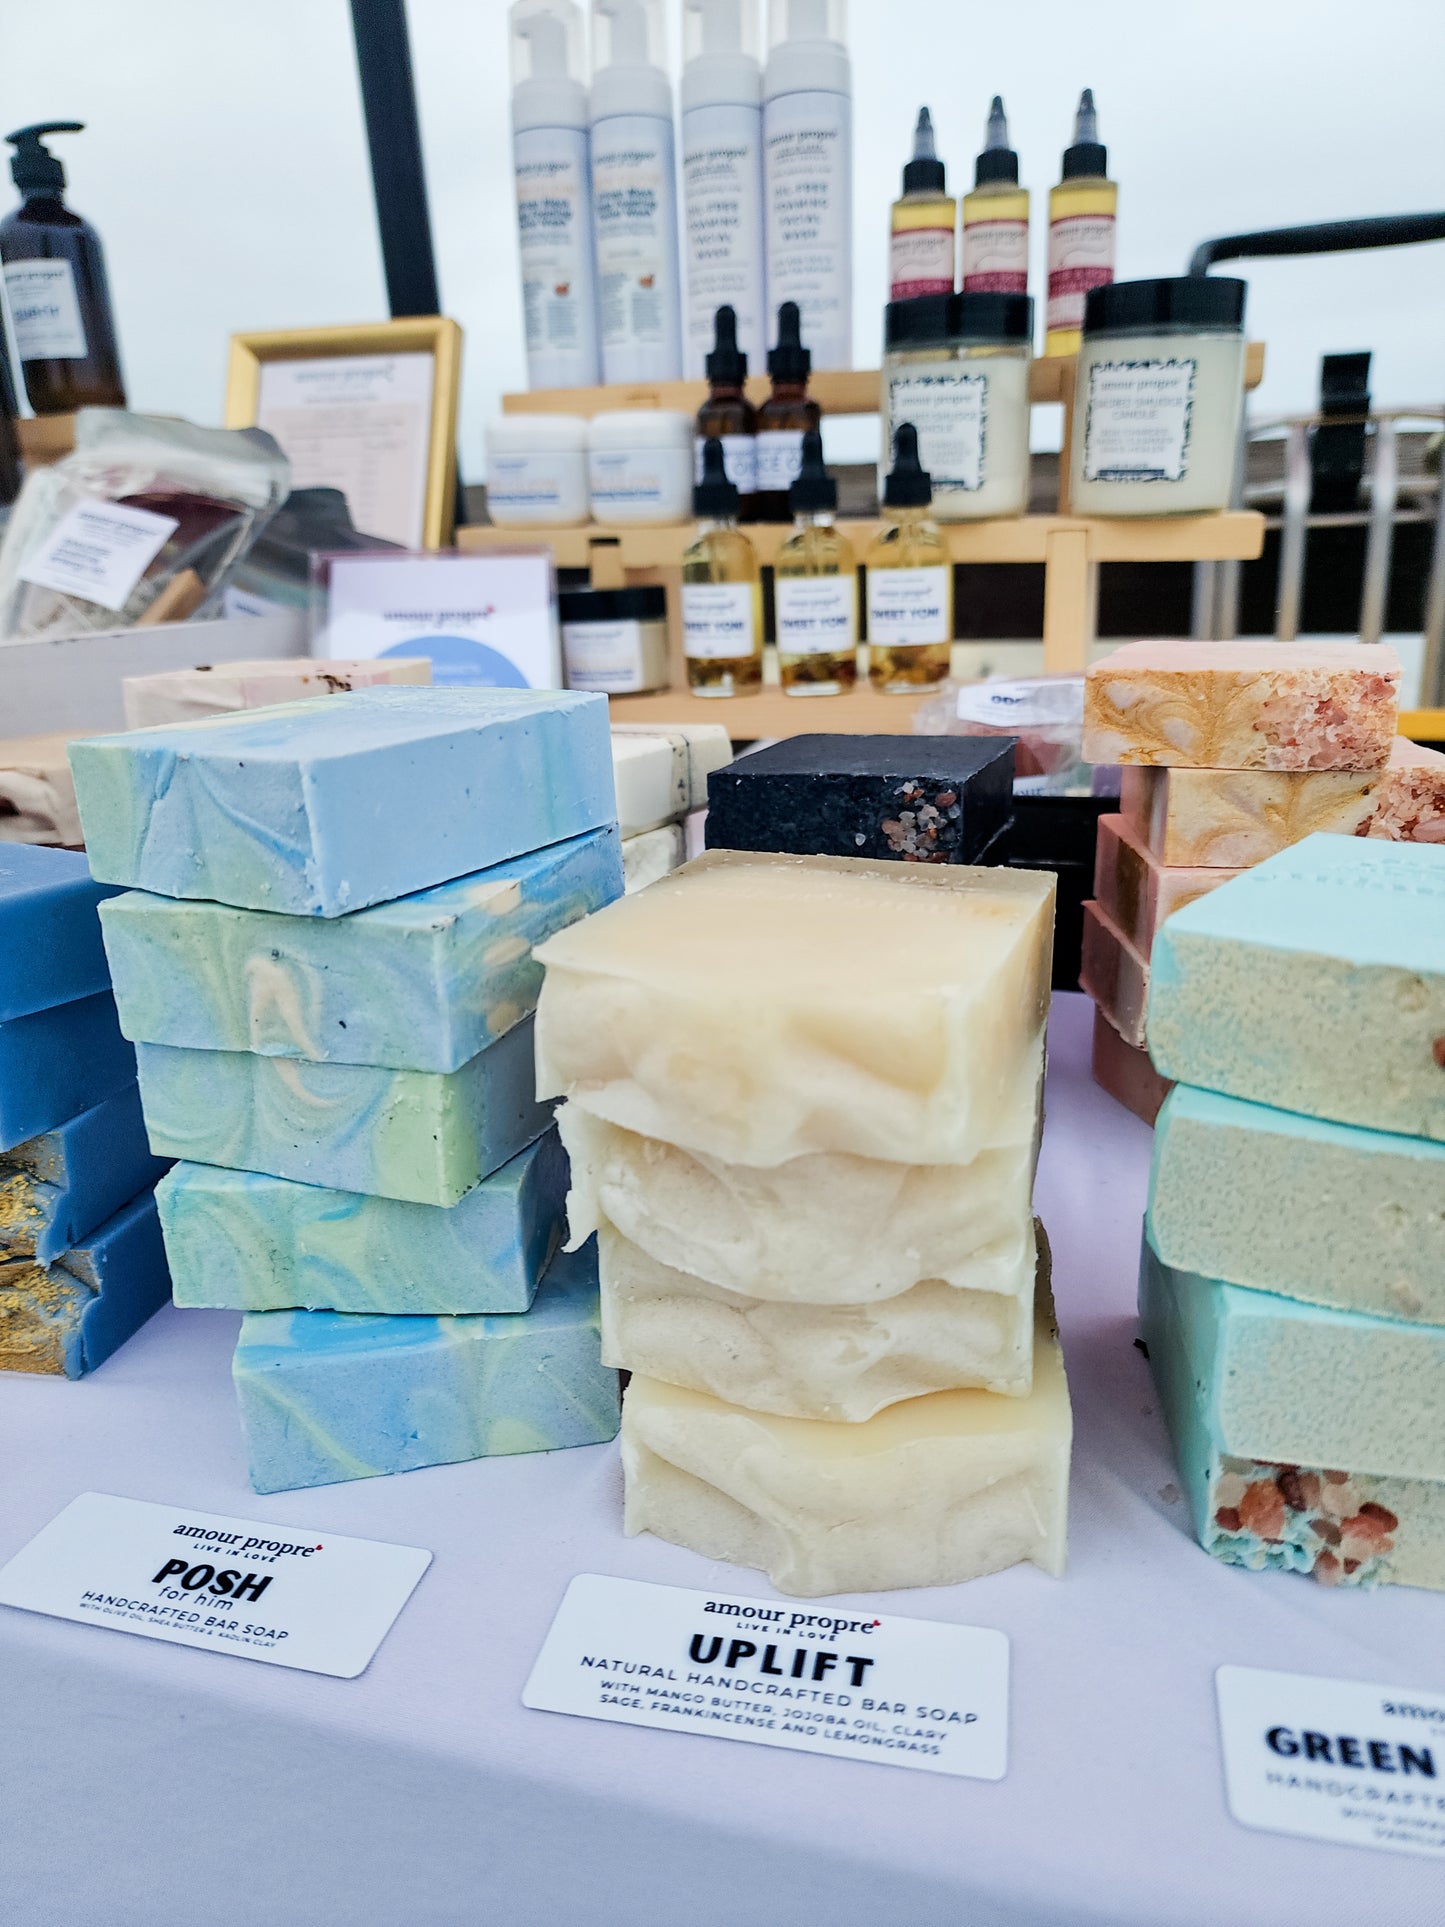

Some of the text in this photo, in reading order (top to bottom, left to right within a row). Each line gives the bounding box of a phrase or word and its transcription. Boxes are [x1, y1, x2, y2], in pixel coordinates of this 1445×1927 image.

[173, 1524, 315, 1557] amour propre
[193, 1543, 222, 1553] LIVE
[244, 1552, 277, 1563] LOVE
[152, 1558, 274, 1602] POSH
[158, 1586, 233, 1611] for him
[81, 1590, 289, 1641] HANDCRAFTED BAR SOAP
[149, 1616, 171, 1627] SHEA
[172, 1621, 205, 1636] BUTTER
[253, 1637, 276, 1648] CLAY
[704, 1601, 875, 1635] amour propre
[736, 1622, 836, 1642] LIVE IN LOVE
[688, 1633, 875, 1688] UPLIFT
[580, 1656, 978, 1725] NATURAL HANDCRAFTED BAR SOAP
[599, 1680, 949, 1740] WITH MANGO BUTTER, JOJOBA OIL, CLARY
[599, 1694, 941, 1756] SAGE, FRANKINCENSE AND LEMONGRASS
[1264, 1725, 1437, 1779] GREEN
